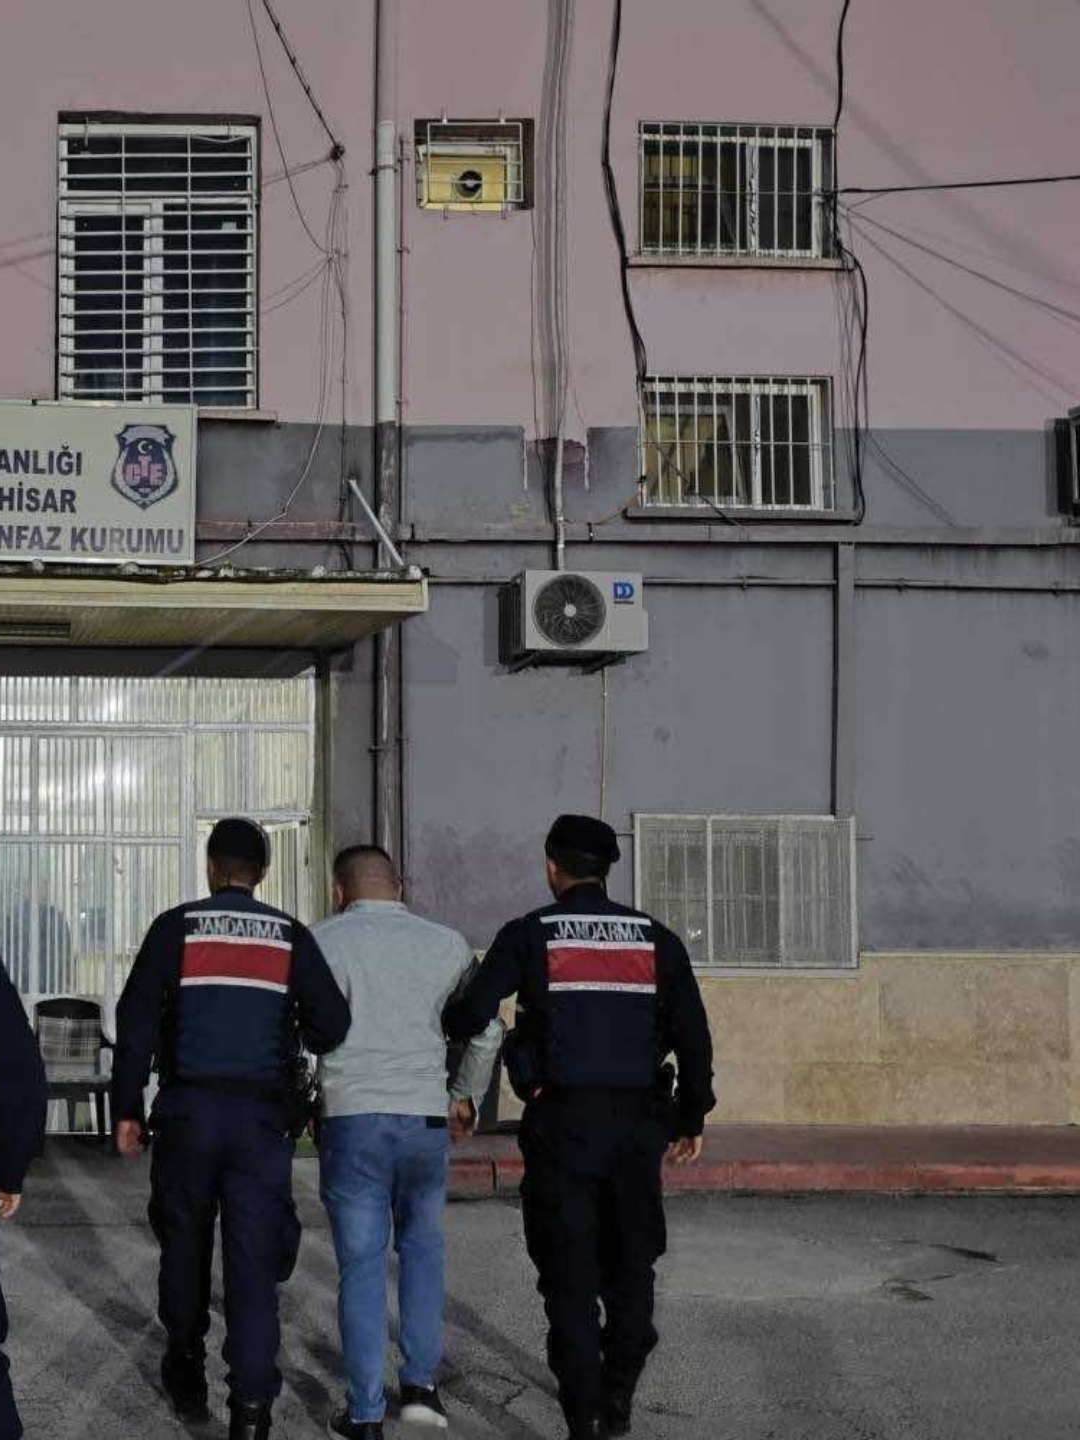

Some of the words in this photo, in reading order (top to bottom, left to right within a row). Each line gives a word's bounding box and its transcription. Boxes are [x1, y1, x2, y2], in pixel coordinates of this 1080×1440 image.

[70, 526, 184, 553] KURUMU
[194, 917, 283, 940] JANDARMA
[554, 920, 645, 942] JANDARMA
